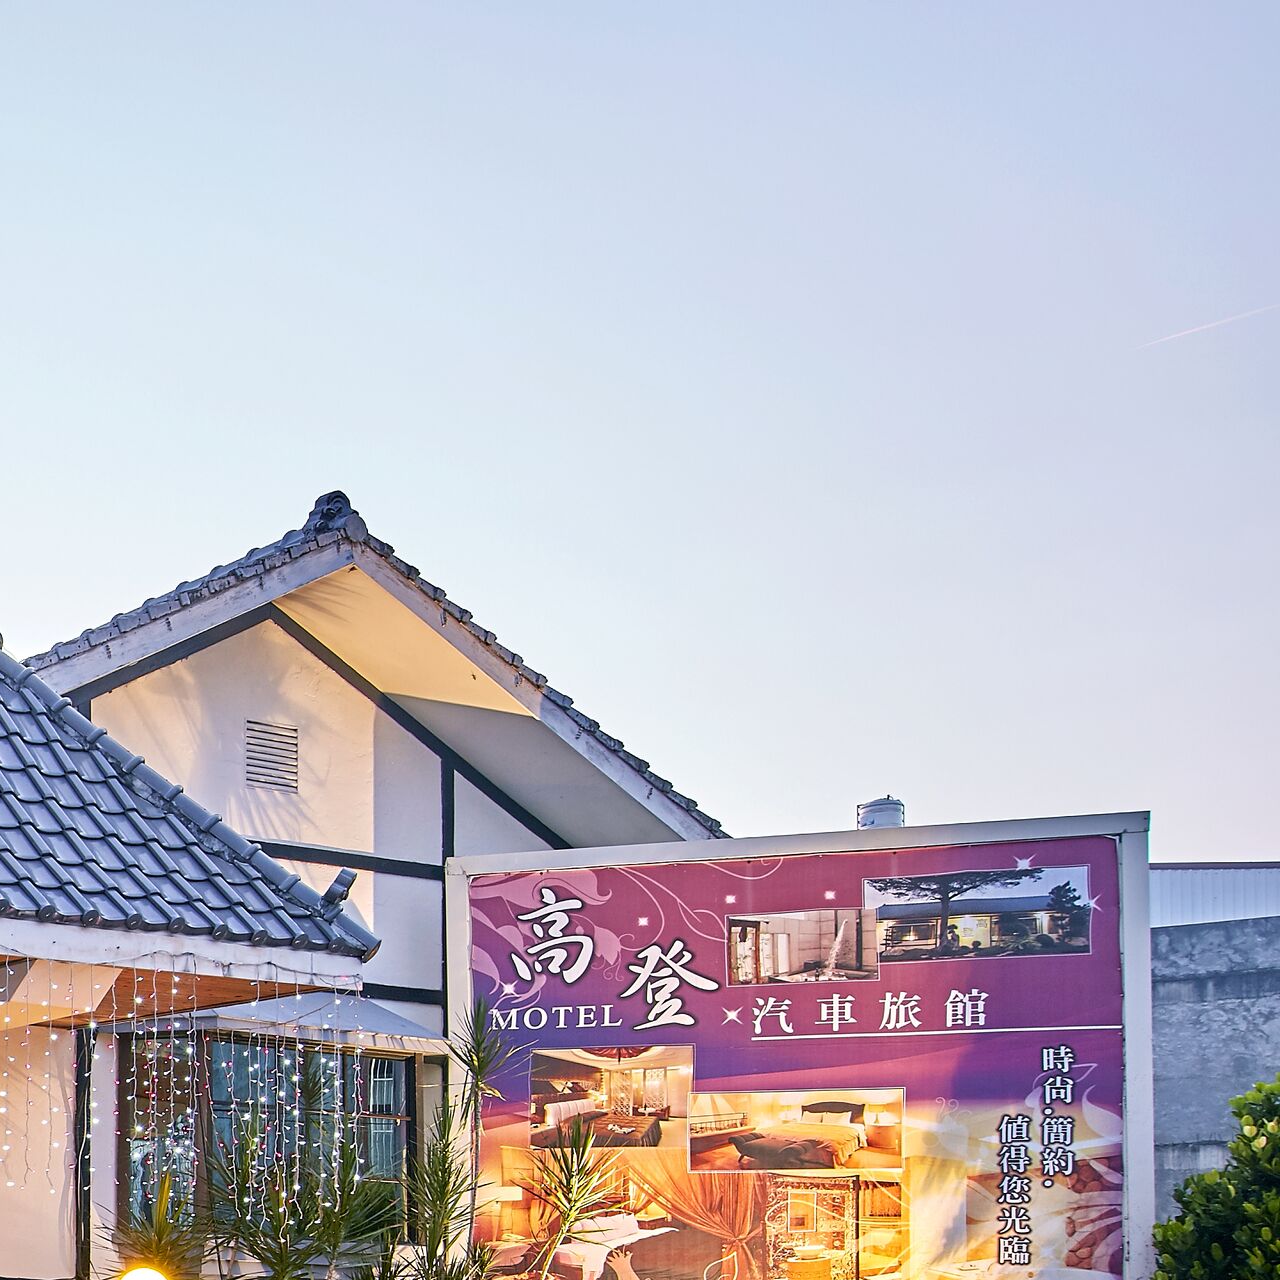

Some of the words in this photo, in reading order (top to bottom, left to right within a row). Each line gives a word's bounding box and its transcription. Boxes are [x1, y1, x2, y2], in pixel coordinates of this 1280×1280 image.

[511, 887, 719, 1031] 高登
[491, 1004, 623, 1031] MOTEL
[751, 988, 989, 1035] 汽車旅館
